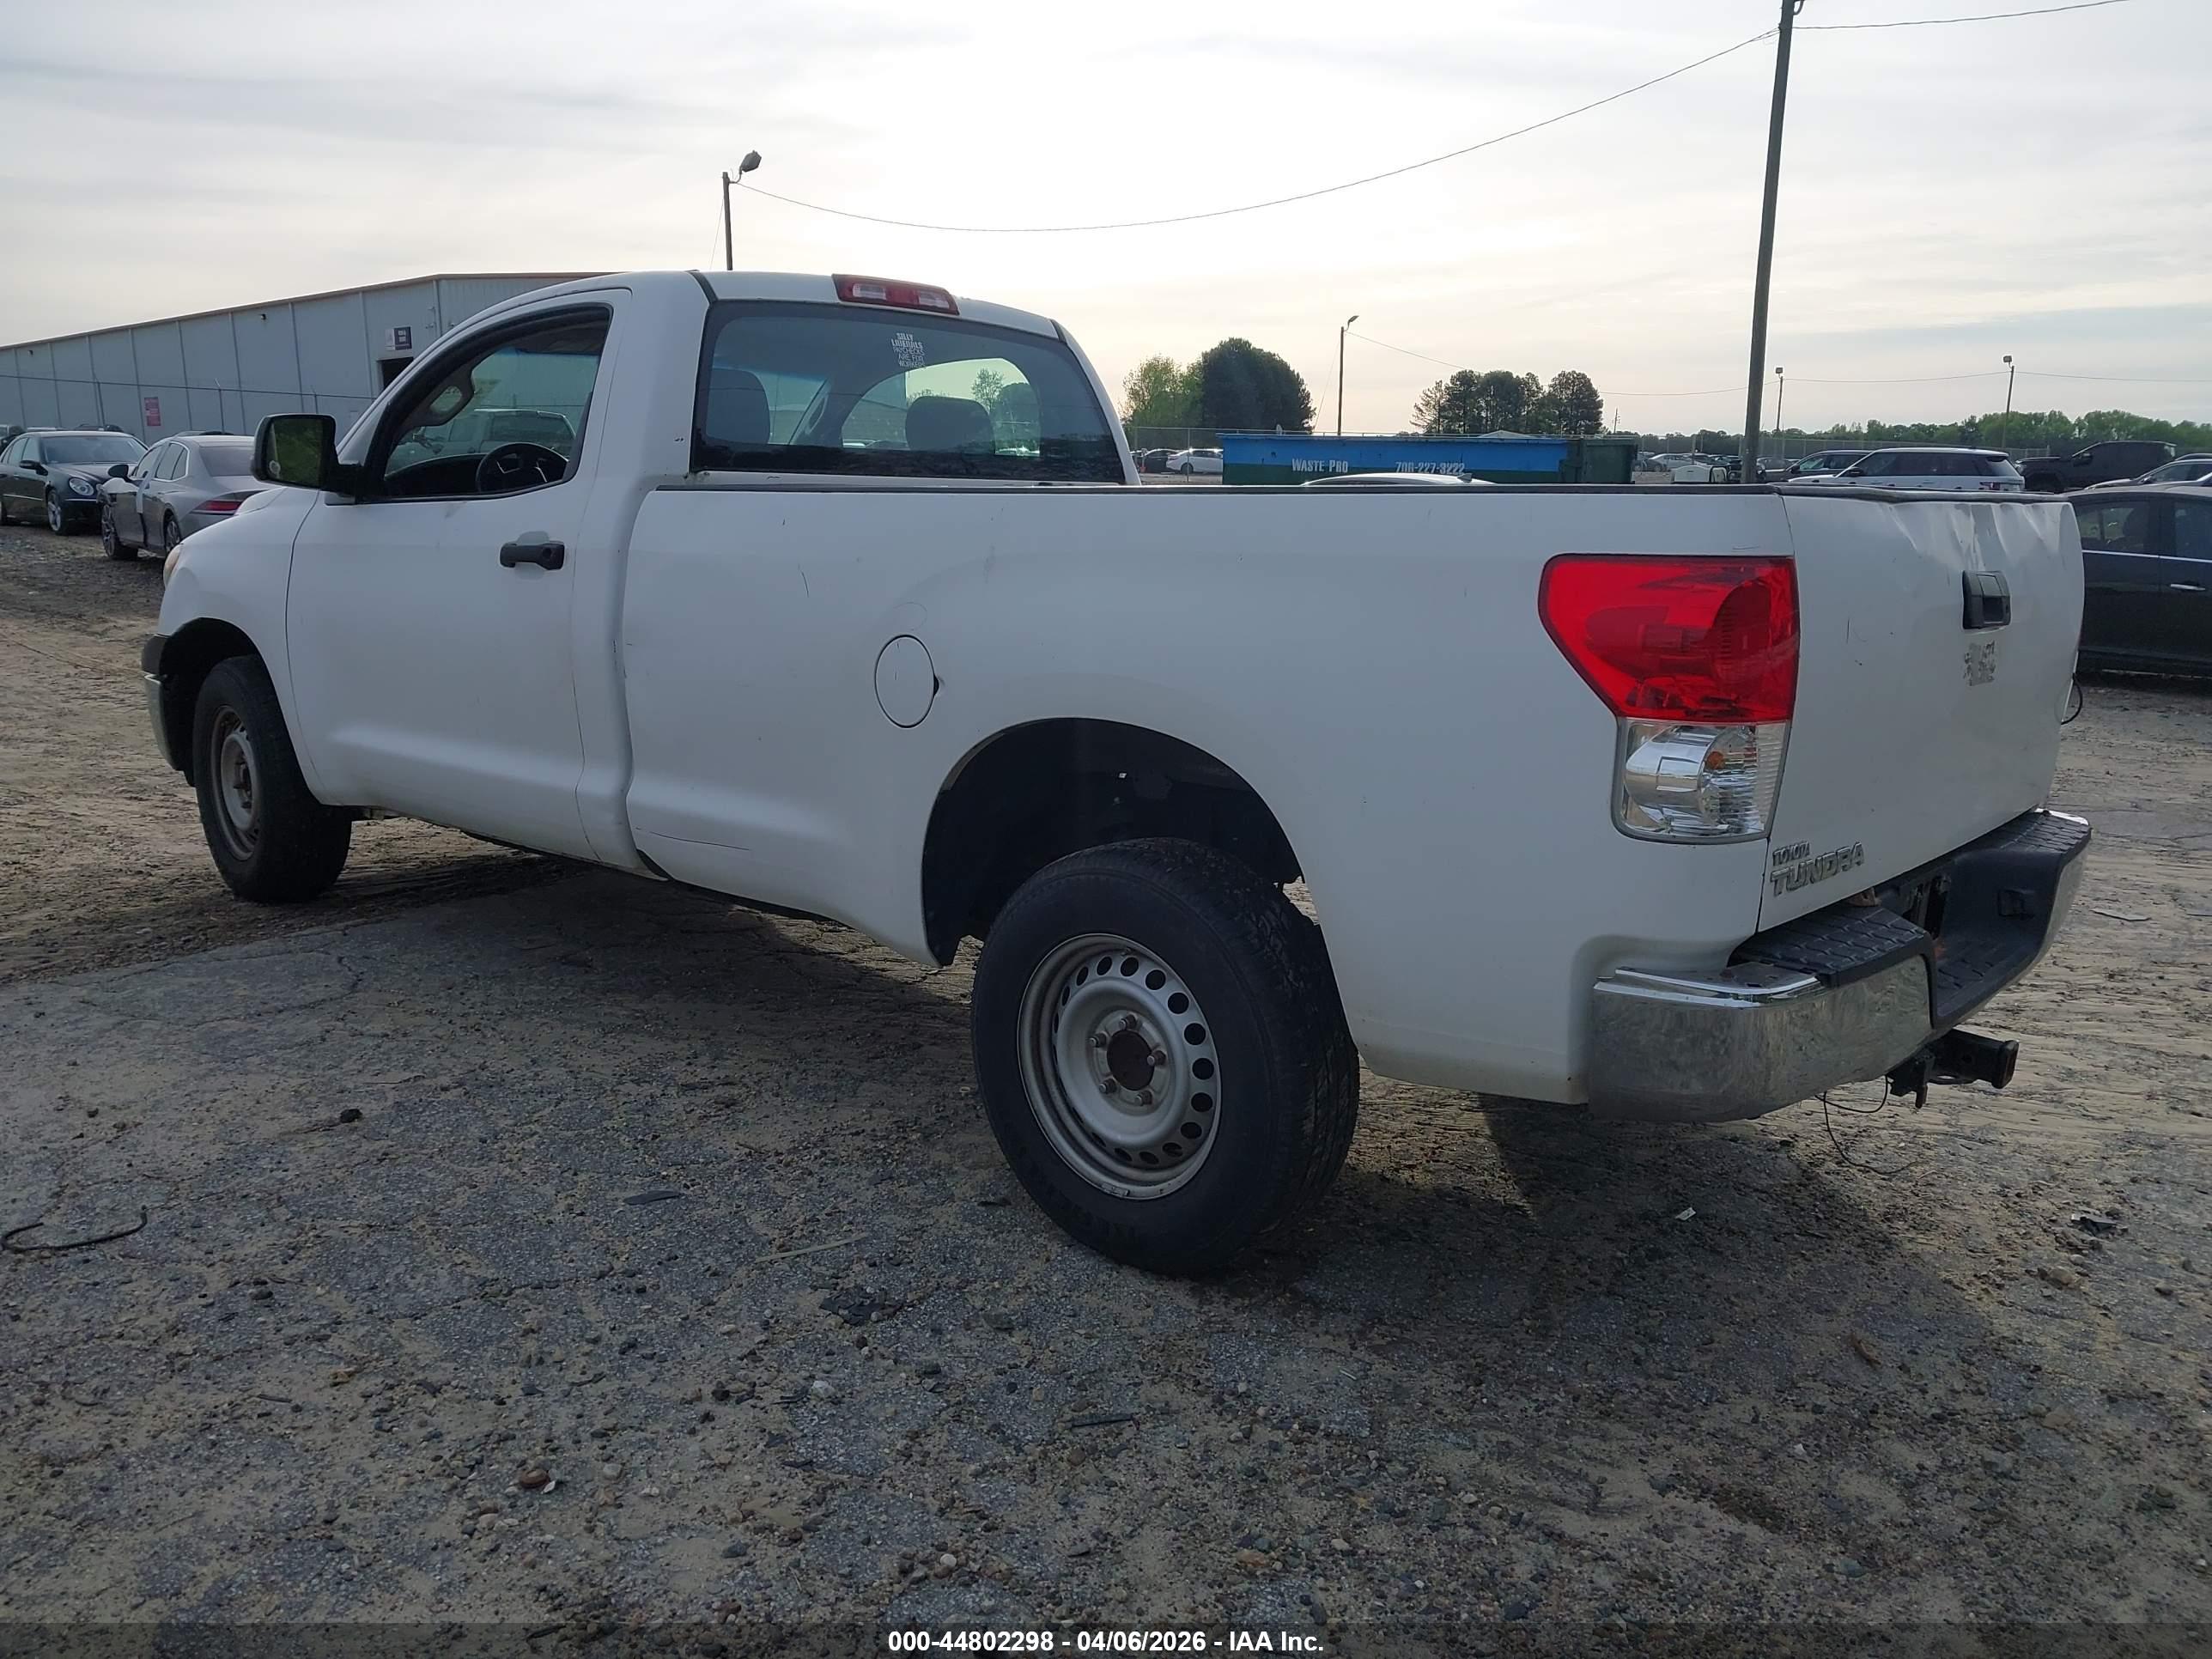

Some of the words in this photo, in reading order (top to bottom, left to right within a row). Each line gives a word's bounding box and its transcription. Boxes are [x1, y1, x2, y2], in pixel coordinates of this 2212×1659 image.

[1328, 459, 1348, 473] PRO
[1772, 841, 1810, 866] TOYOTA
[1770, 842, 1864, 896] TUNDRA
